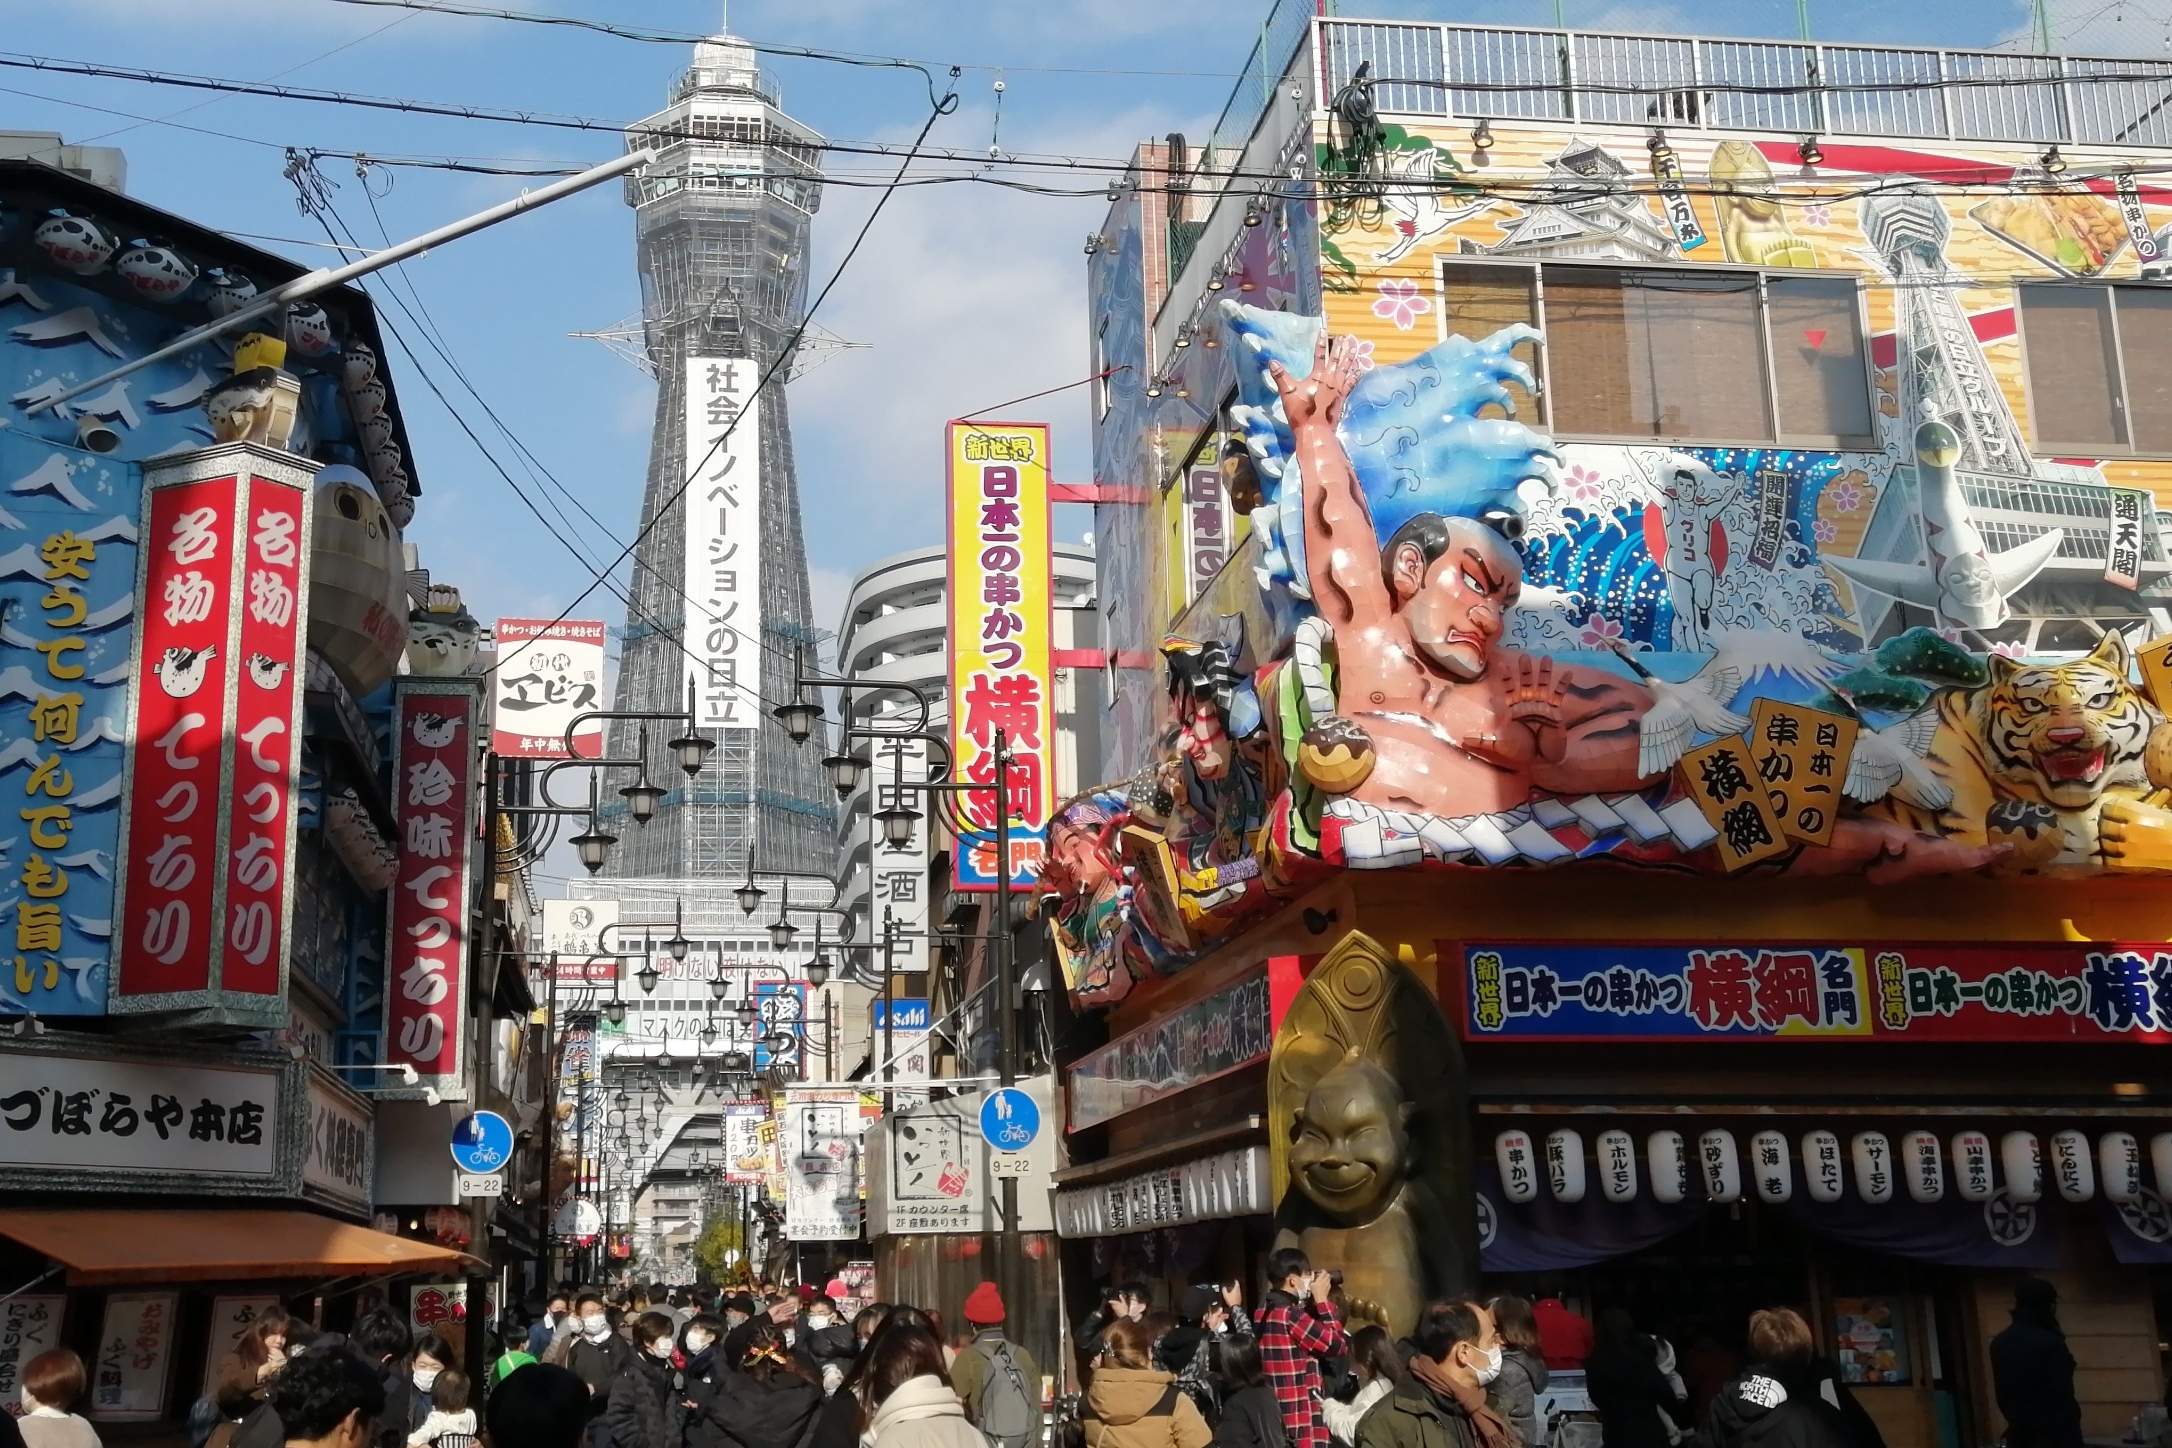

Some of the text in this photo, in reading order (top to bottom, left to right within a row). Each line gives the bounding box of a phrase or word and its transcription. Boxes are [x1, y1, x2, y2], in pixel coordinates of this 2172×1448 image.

[1658, 157, 1700, 242] 千客万来
[965, 436, 1034, 462] 新世界
[704, 363, 740, 723] 社会イノベーションの日立
[1680, 519, 1697, 562] グリコ
[1754, 474, 1785, 562] 開運招福
[2111, 493, 2140, 578] 通天閣
[981, 465, 1023, 669] 日本一の串かつ
[529, 653, 572, 671] 初代
[13, 530, 96, 995] 安うて何んでも旨い
[142, 507, 219, 966] 名物 てっちり
[230, 508, 296, 967] 名物 てっちり
[964, 674, 1042, 829] 横綱
[1759, 712, 1800, 820] 串かつ
[1698, 749, 1774, 858] 横綱
[1797, 721, 1840, 834] 日本一の
[400, 756, 457, 1063] 珍味てっちり
[1476, 953, 1858, 1028] 新世界 日本一の串かつ 横綱 名門
[1878, 956, 1907, 1028] 新世界
[1908, 970, 2083, 1014] 日本一の串かつ
[0, 1087, 265, 1146] づぼらや本店
[462, 1180, 499, 1192] 9-22
[993, 1156, 1030, 1172] 9-22
[1508, 1149, 1530, 1195] 串かつ
[1611, 1146, 1630, 1195] ホルモン
[1705, 1147, 1725, 1195] 砂ずり
[1820, 1147, 1838, 1193] ほたて
[1867, 1147, 1888, 1196] サーモン
[25, 1302, 49, 1345] ふぐ
[1752, 1374, 1772, 1388] THE
